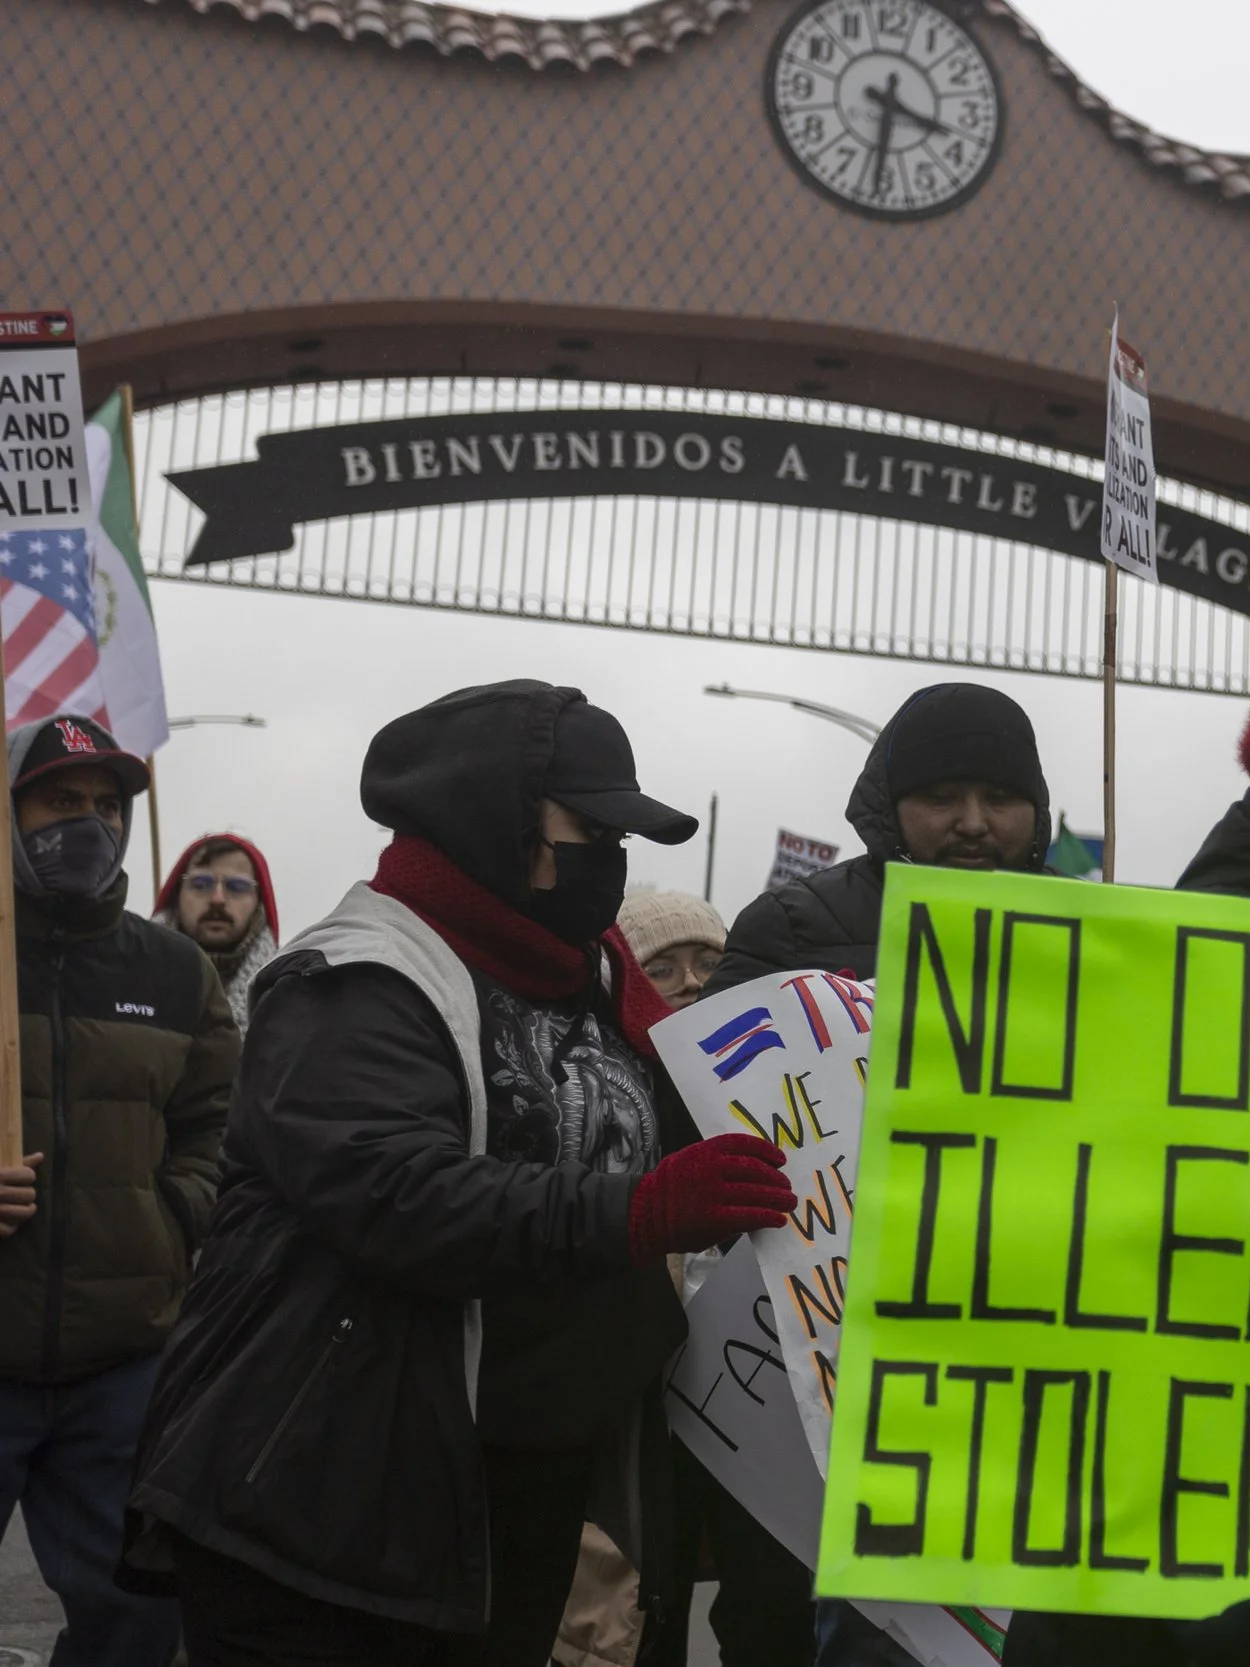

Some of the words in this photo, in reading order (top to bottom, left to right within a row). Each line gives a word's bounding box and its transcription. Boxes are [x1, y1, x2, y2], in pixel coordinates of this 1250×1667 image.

[3, 411, 70, 441] AND
[341, 431, 745, 487] BIENVENIDOS
[776, 444, 808, 482] A
[842, 451, 1038, 519] LITTLE
[1122, 452, 1148, 487] AND
[1117, 515, 1152, 568] ALL!
[55, 720, 97, 752] LA
[895, 901, 1081, 1102] NO
